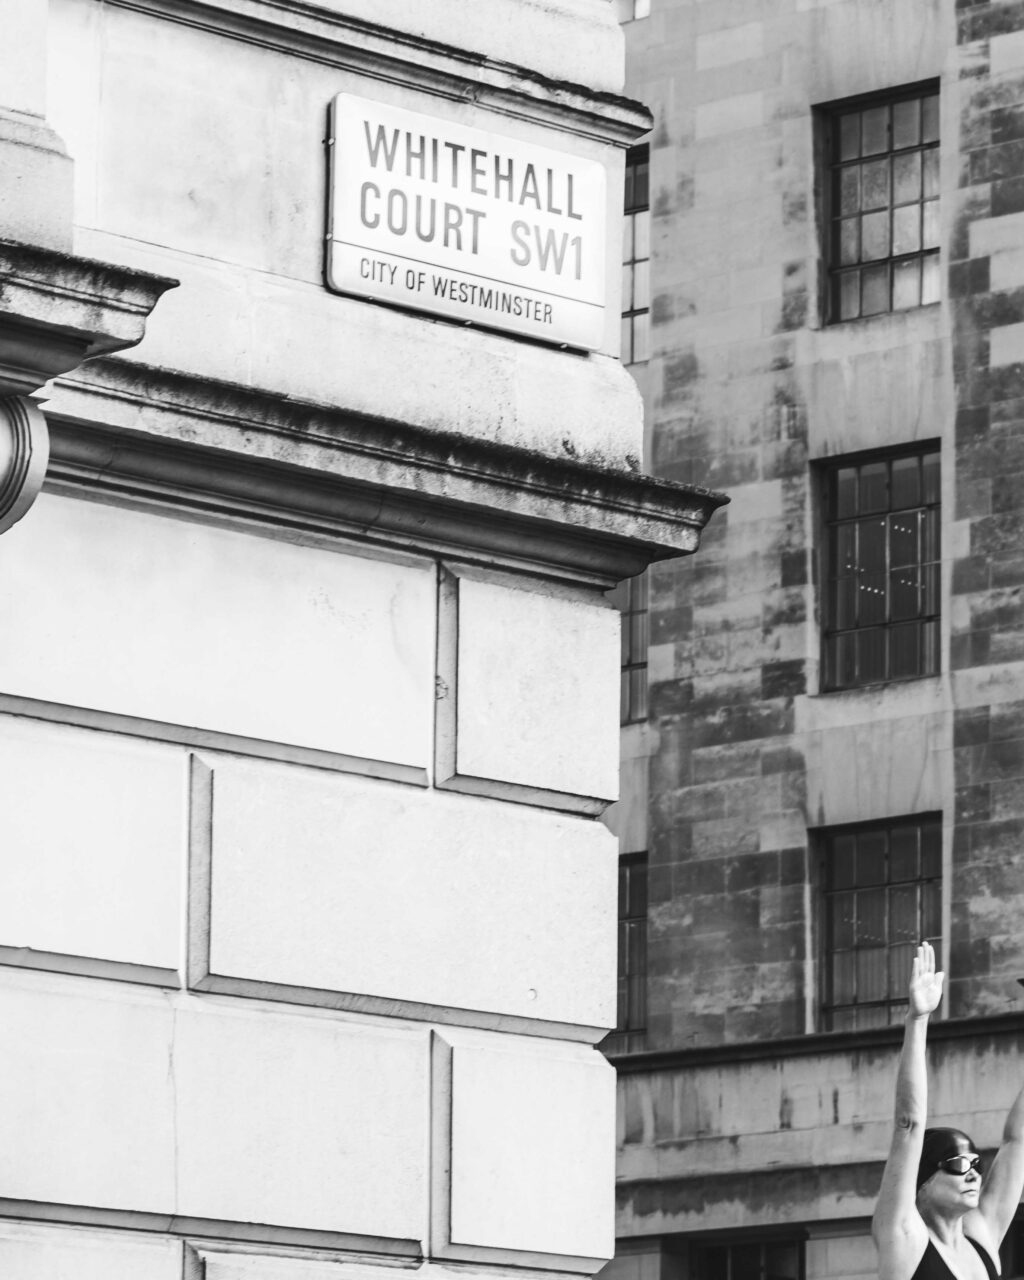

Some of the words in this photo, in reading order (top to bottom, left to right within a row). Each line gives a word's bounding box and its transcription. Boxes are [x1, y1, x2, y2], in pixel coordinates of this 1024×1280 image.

[363, 119, 583, 221] WHITEHALL
[359, 181, 487, 255] COURT
[510, 219, 583, 281] SW1
[359, 257, 398, 286] CITY
[405, 269, 426, 292] OF
[432, 274, 553, 324] WESTMINSTER
